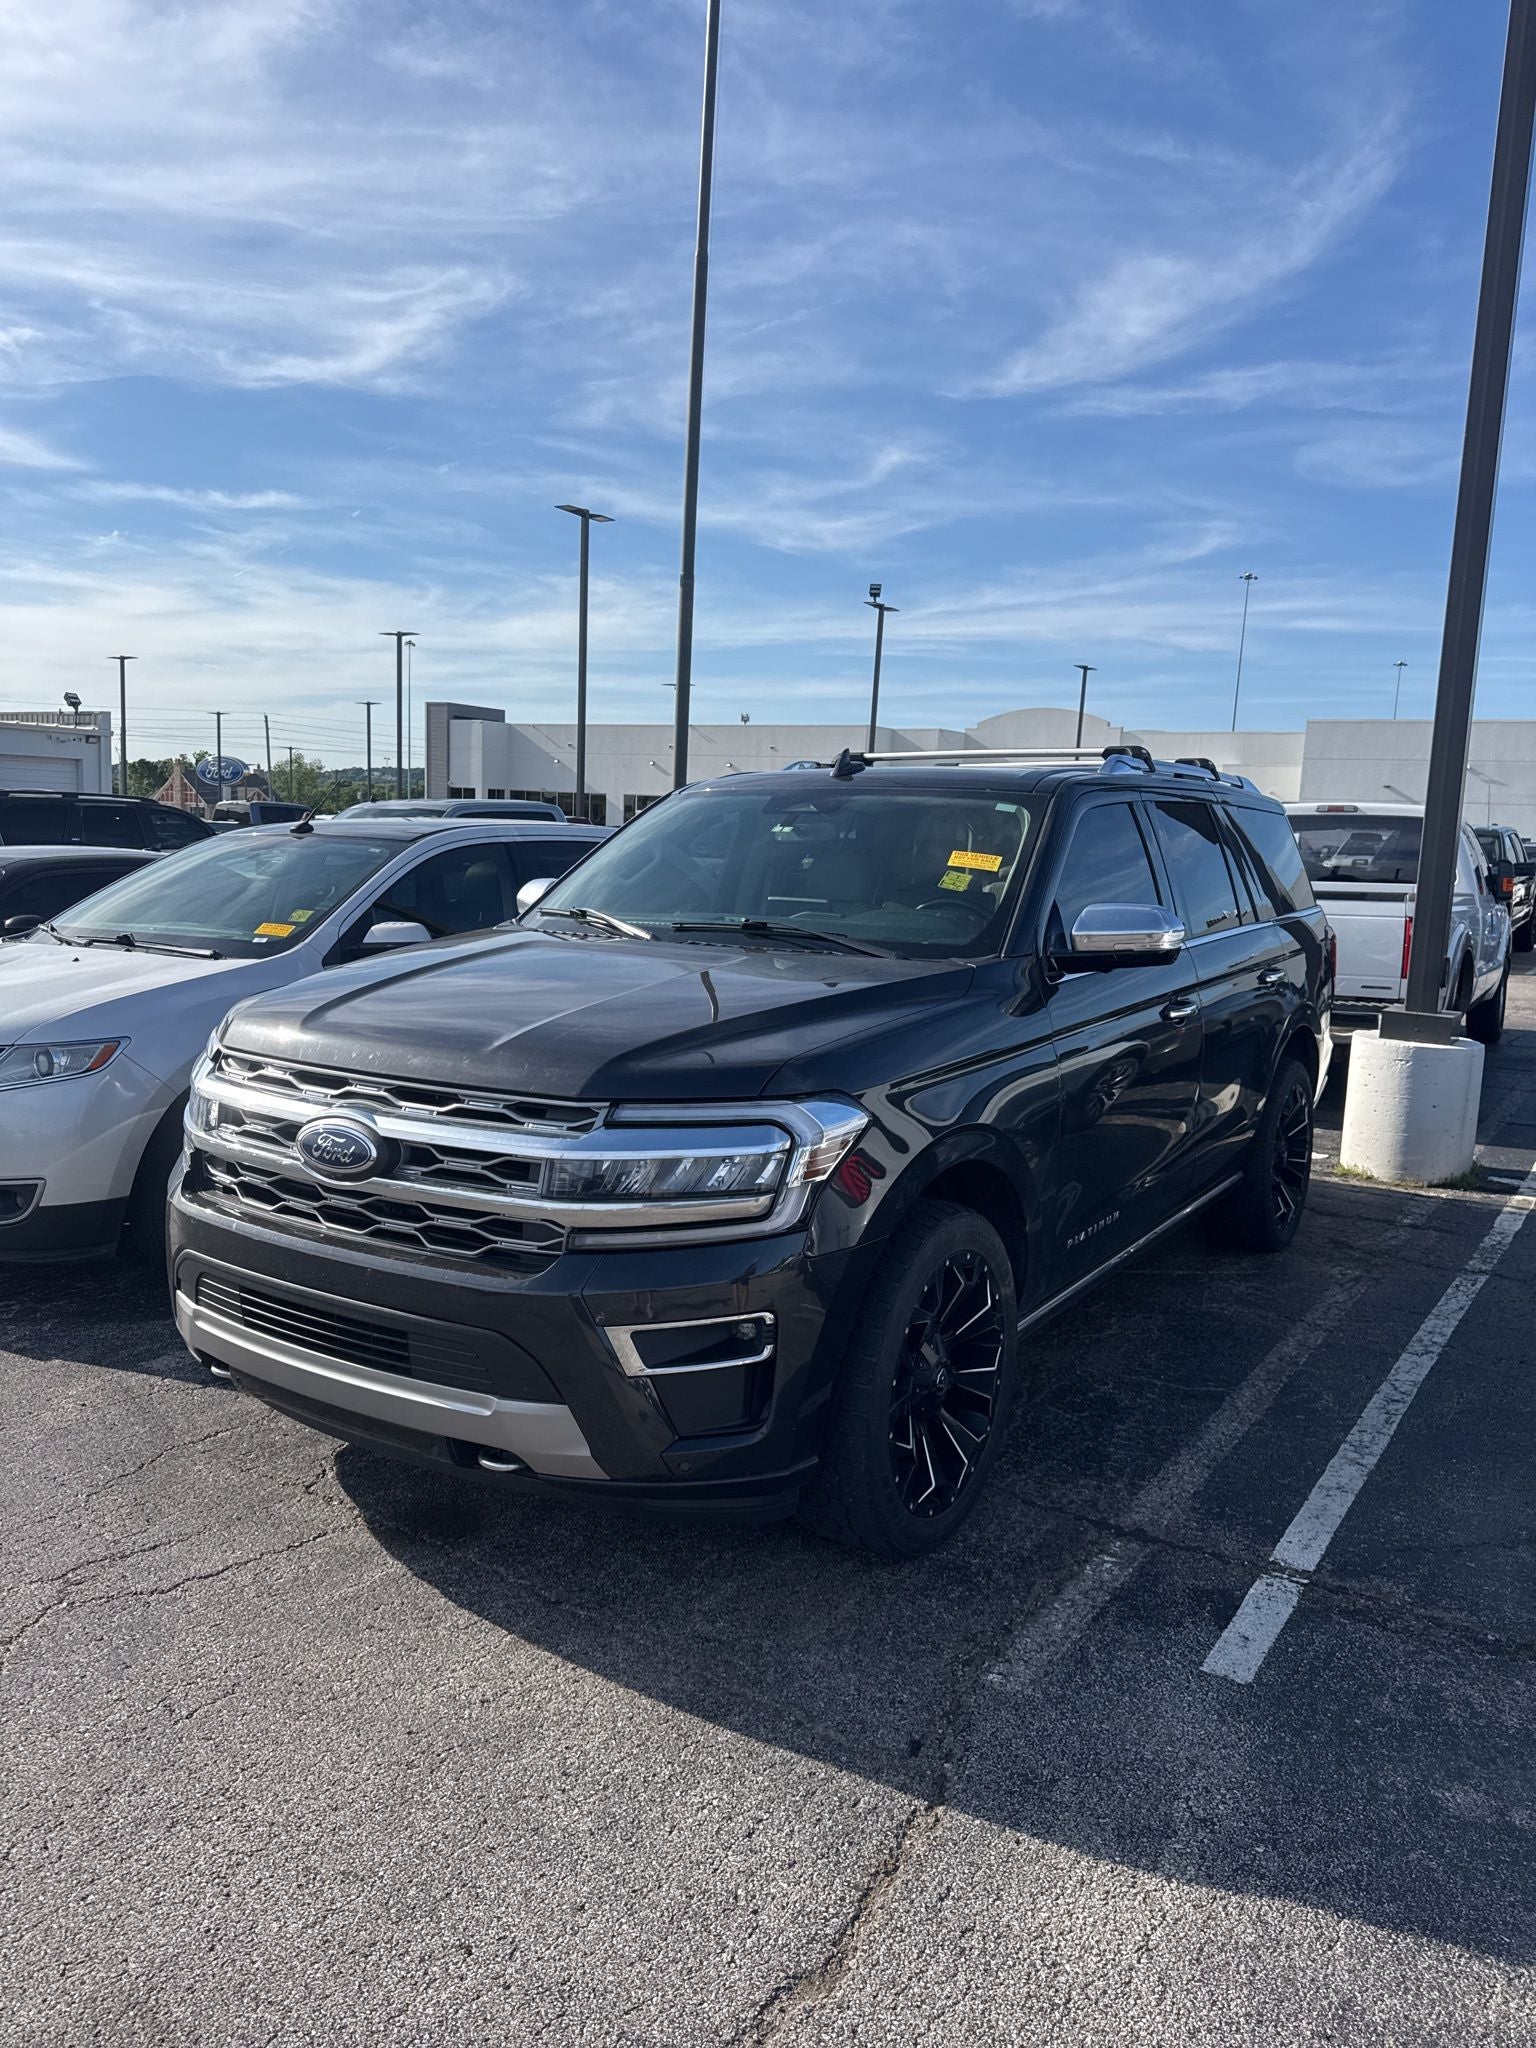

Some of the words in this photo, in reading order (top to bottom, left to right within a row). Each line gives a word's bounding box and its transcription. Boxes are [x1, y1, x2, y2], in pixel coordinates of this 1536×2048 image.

[206, 761, 234, 780] Ford
[970, 853, 999, 861] VEHICLE
[312, 1132, 356, 1163] Ford
[1067, 1210, 1120, 1249] PLATINUM
